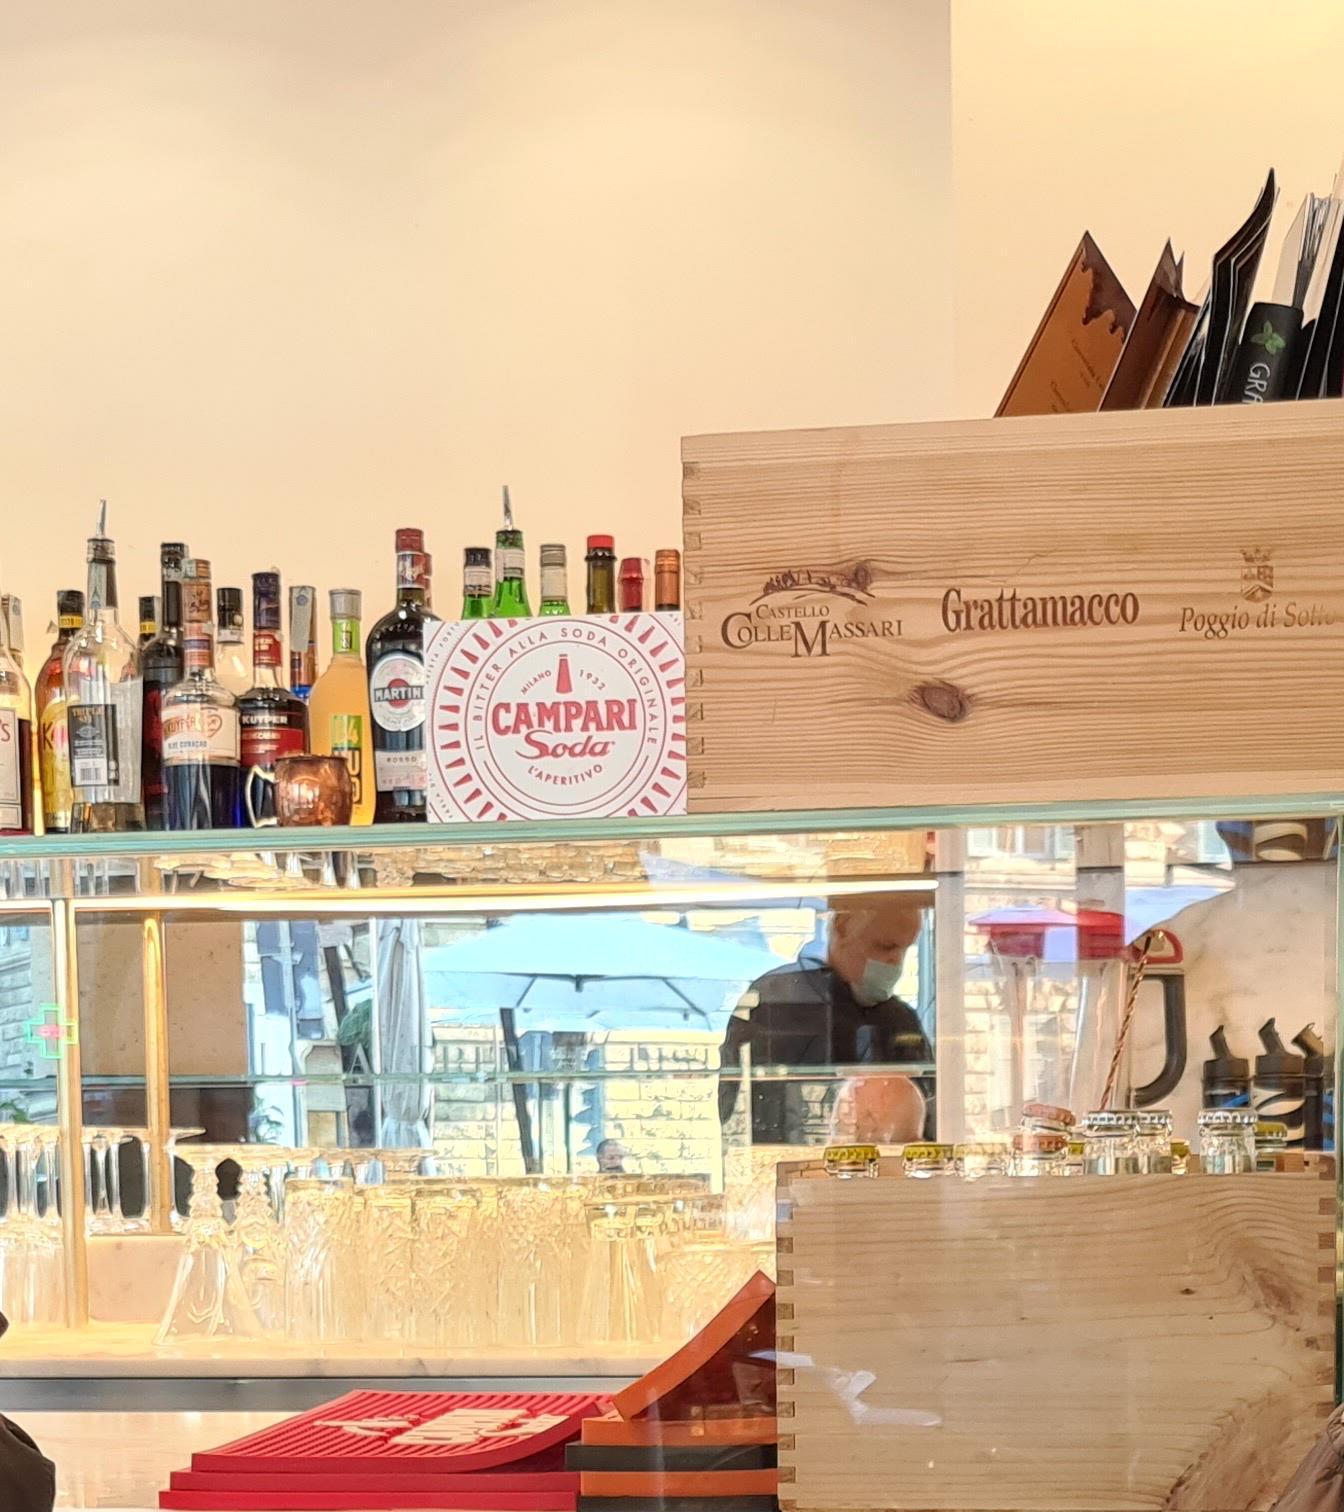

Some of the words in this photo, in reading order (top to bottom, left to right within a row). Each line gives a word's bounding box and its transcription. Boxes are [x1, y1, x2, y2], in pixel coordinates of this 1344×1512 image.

[755, 603, 830, 620] CASTELLO
[941, 587, 1140, 633] Grattamacco
[1178, 606, 1250, 640] Poggio
[1256, 602, 1277, 629] di
[509, 631, 549, 658] ALLA
[560, 627, 607, 648] SODA
[375, 686, 422, 701] MARTIN
[472, 663, 503, 722] BITTER
[520, 669, 552, 695] MILANO
[578, 669, 606, 692] 1932
[617, 648, 660, 745] ORIGINALE
[491, 698, 638, 736] CAMPARI
[473, 735, 485, 750] IL
[515, 730, 612, 760] Soda
[528, 764, 603, 786] L'APERITIVO
